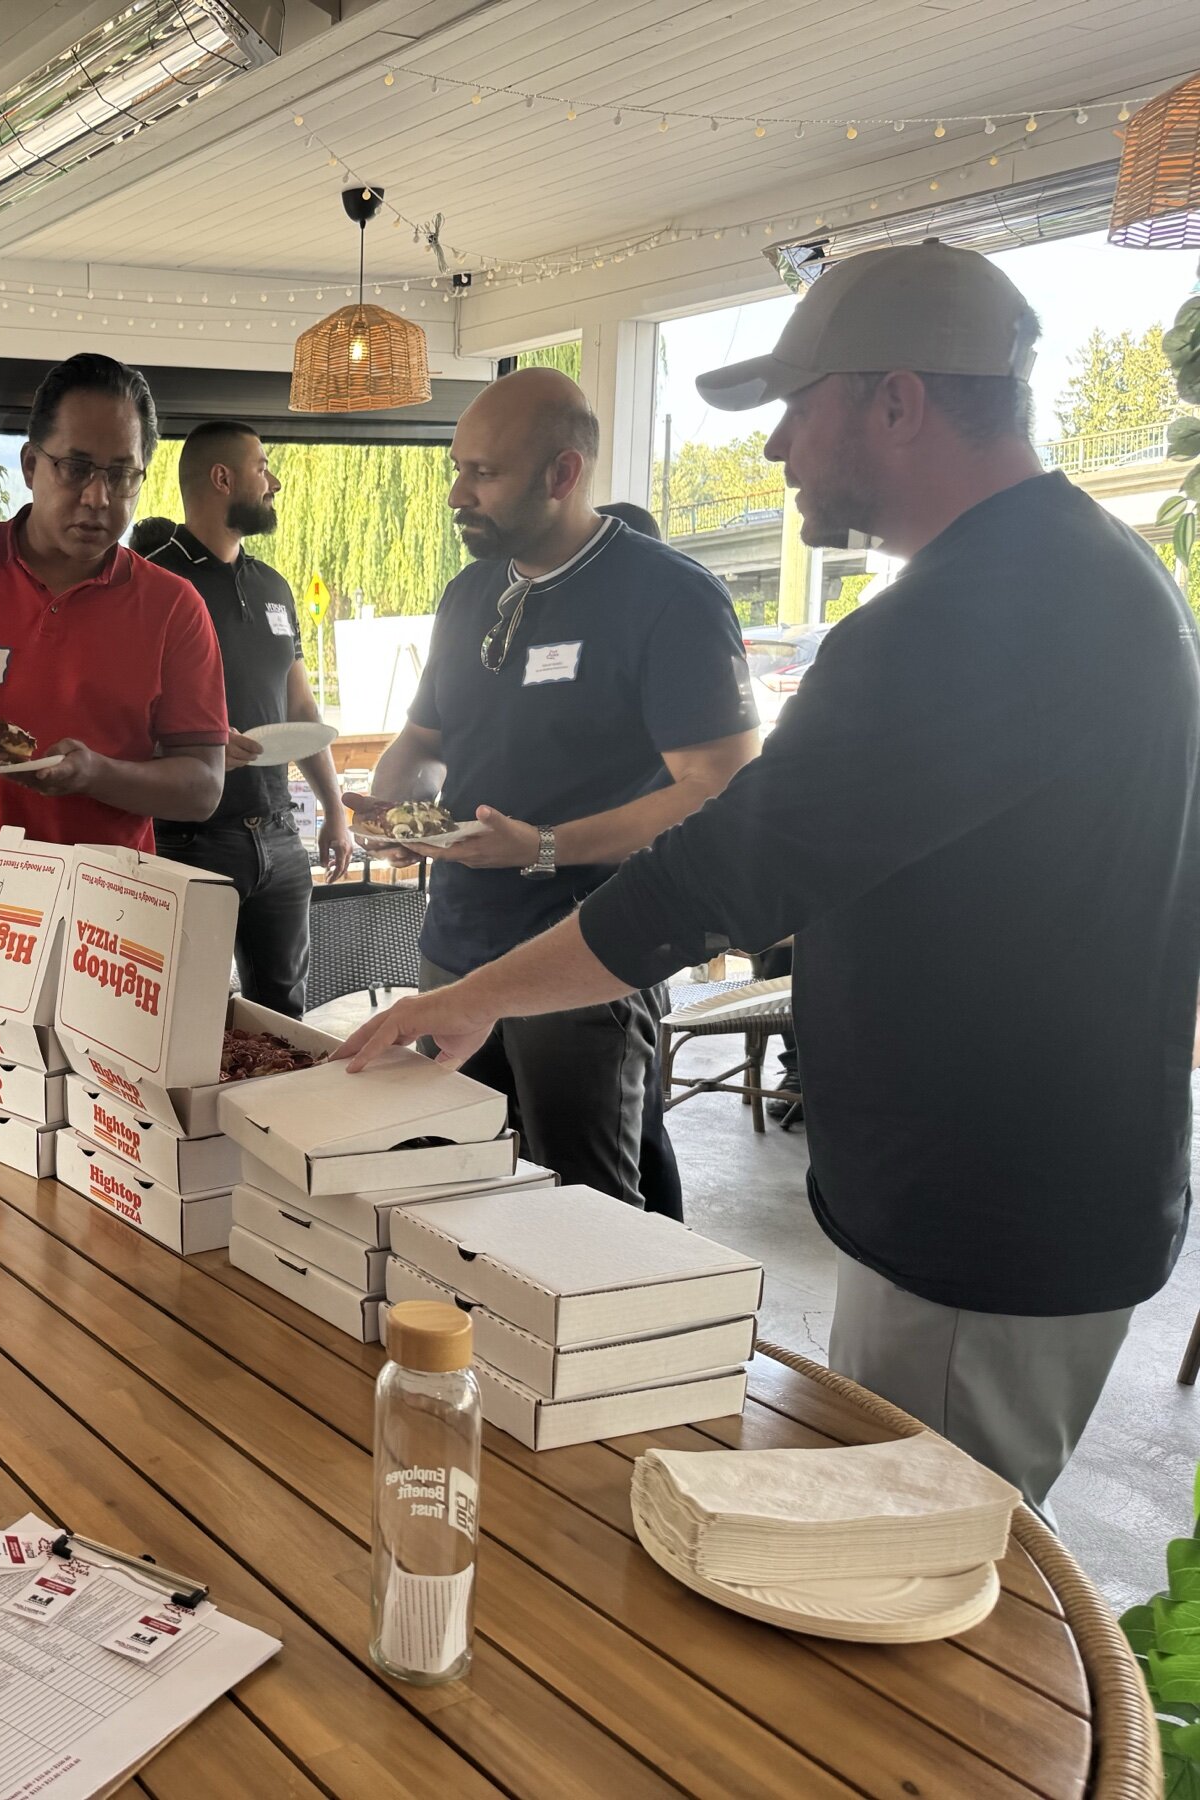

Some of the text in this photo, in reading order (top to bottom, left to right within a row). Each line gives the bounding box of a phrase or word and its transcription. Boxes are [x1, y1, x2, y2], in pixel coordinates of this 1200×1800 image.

[20, 861, 41, 872] Moody's
[42, 866, 55, 874] Port
[77, 919, 118, 955] PIZZA
[73, 943, 161, 1016] Hightop
[89, 1058, 140, 1097] Hightop
[120, 1088, 147, 1111] PIZZA
[93, 1103, 140, 1146] Hightop
[117, 1138, 141, 1163] PIZZA
[90, 1164, 142, 1210] Hightop
[116, 1199, 142, 1225] PIZZA
[69, 1565, 90, 1576] SWA
[174, 1604, 197, 1616] SWA
